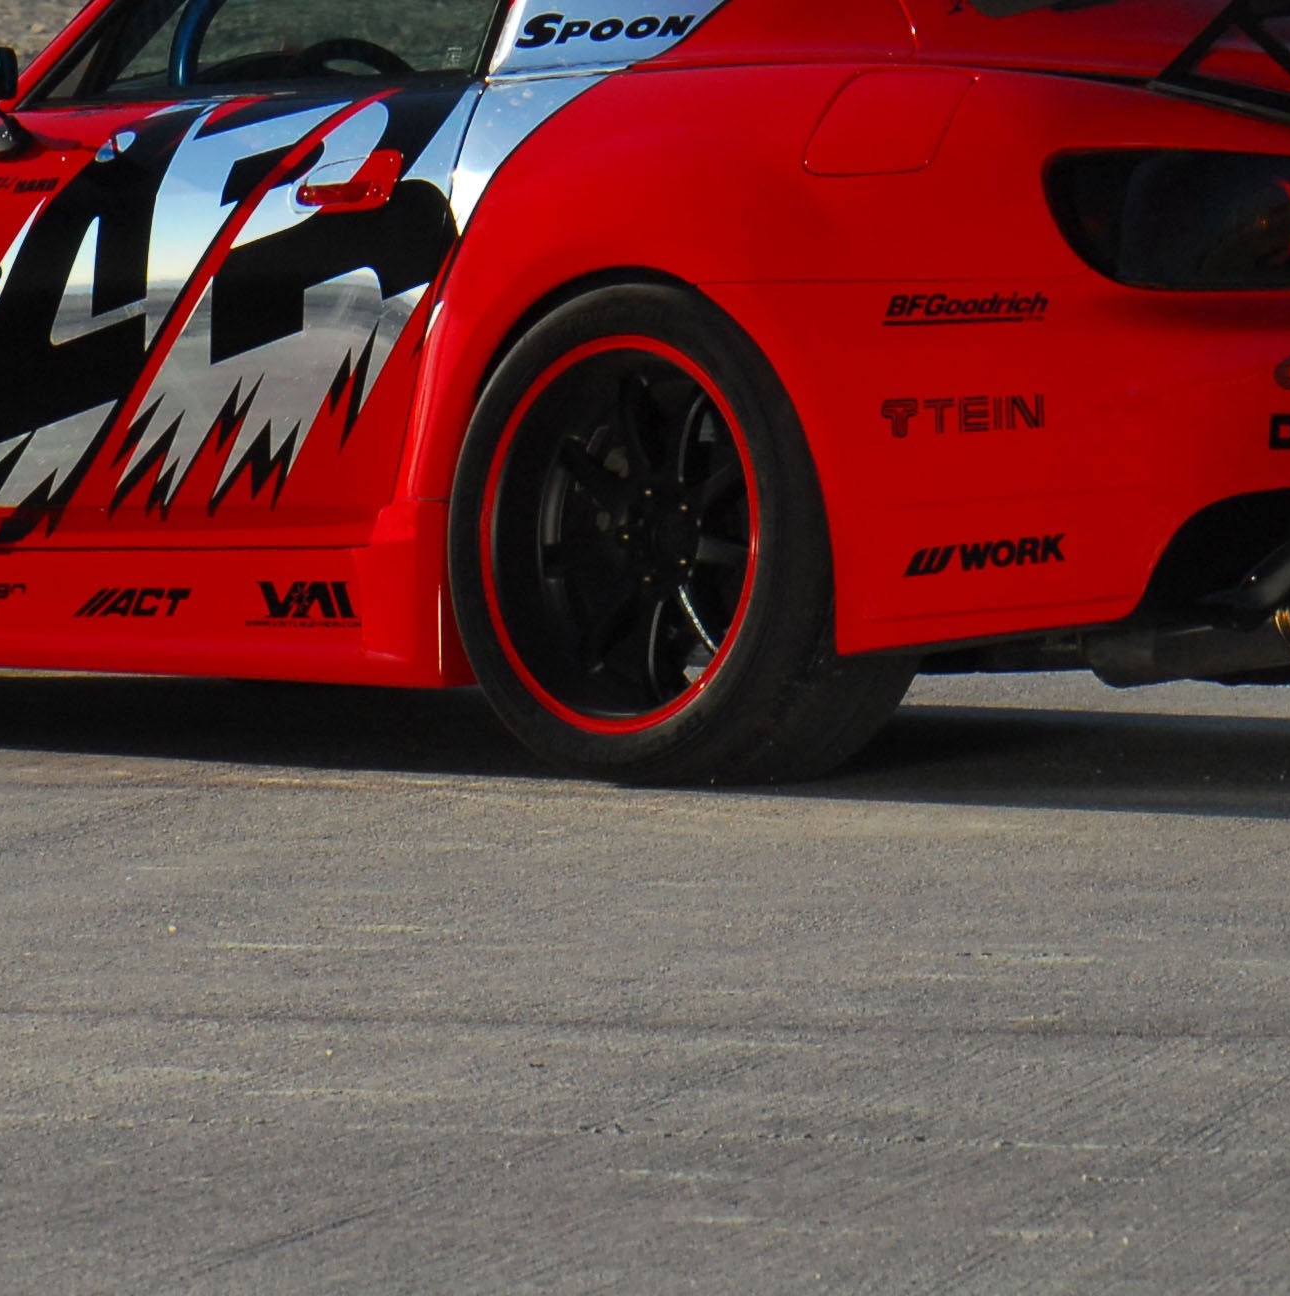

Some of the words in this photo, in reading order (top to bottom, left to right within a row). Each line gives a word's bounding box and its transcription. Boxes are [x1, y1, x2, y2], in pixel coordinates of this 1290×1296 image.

[885, 291, 1050, 317] BFGoodrich
[922, 393, 1045, 434] TEIN
[957, 533, 1066, 572] WORK
